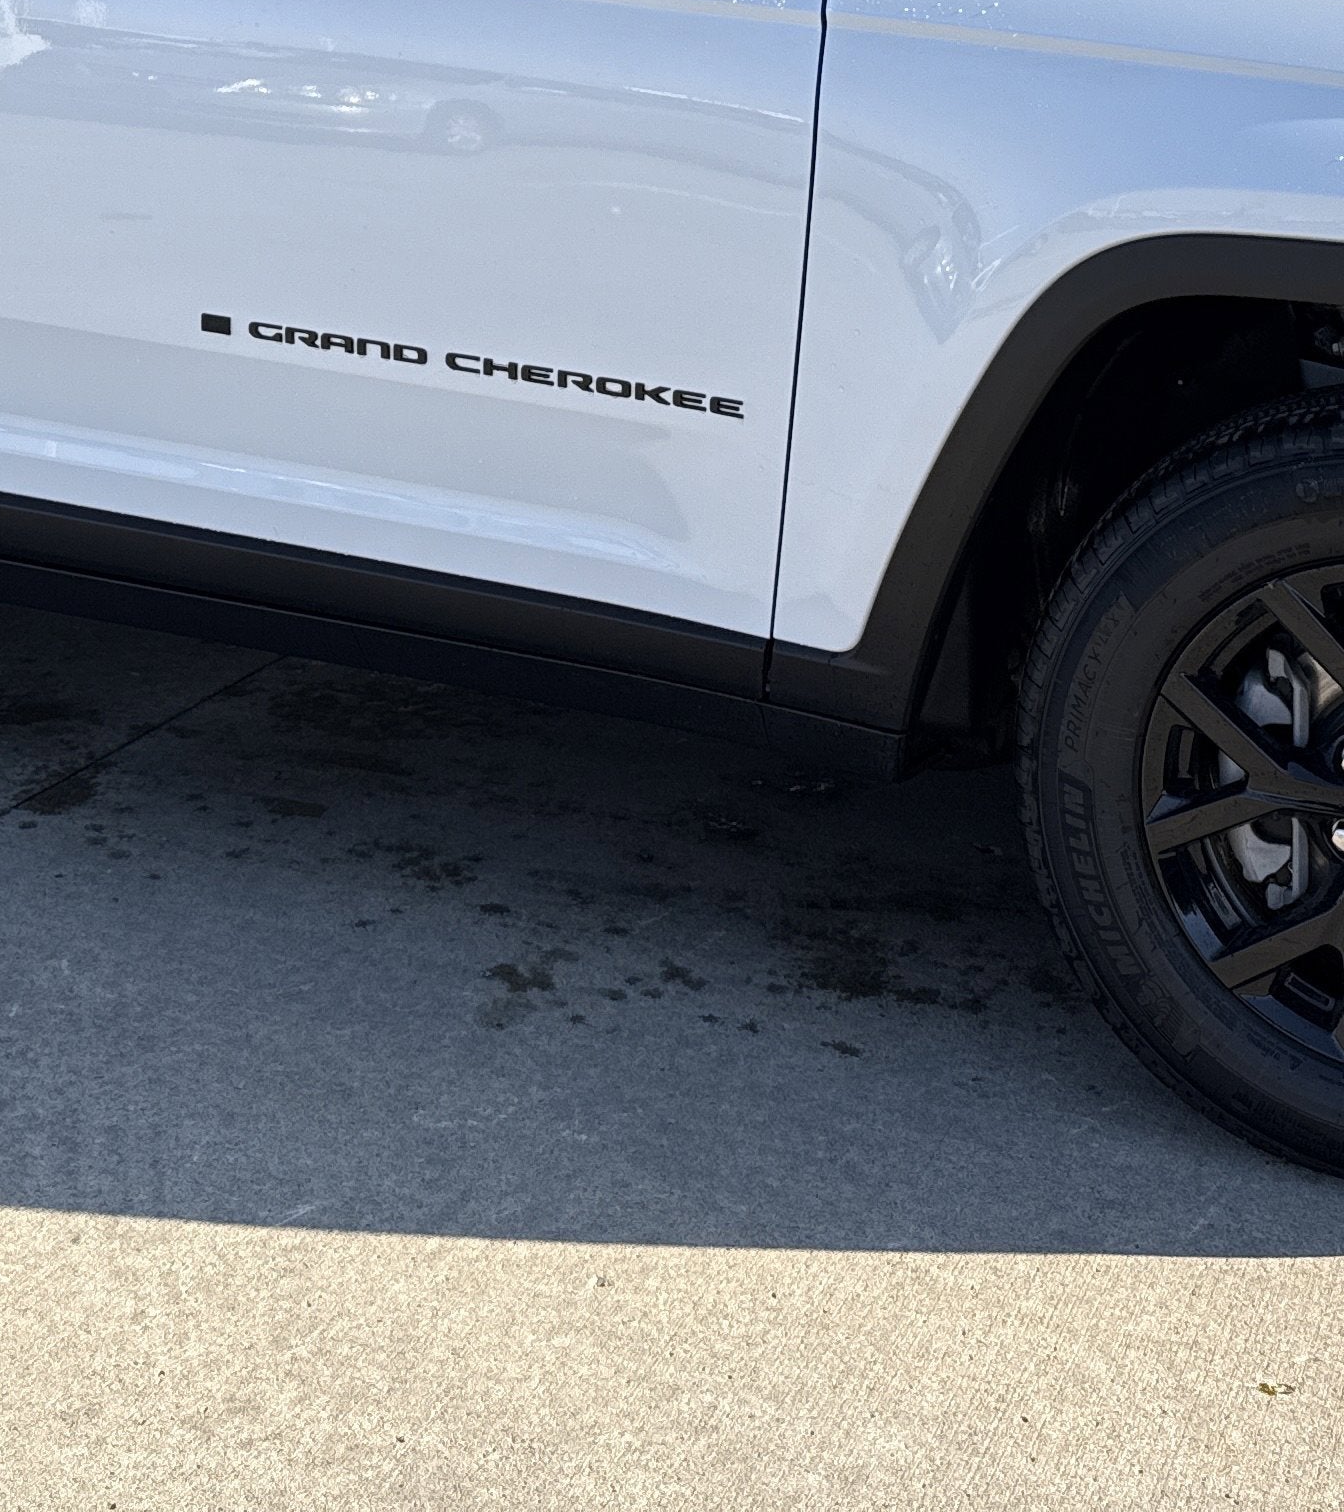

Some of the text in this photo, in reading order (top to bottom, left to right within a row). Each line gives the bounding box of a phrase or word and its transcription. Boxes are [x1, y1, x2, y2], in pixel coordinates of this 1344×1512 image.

[248, 321, 745, 419] GRAND CHEROKEE
[1064, 650, 1103, 753] PRIMACY
[1063, 782, 1142, 975] MICHELIN
